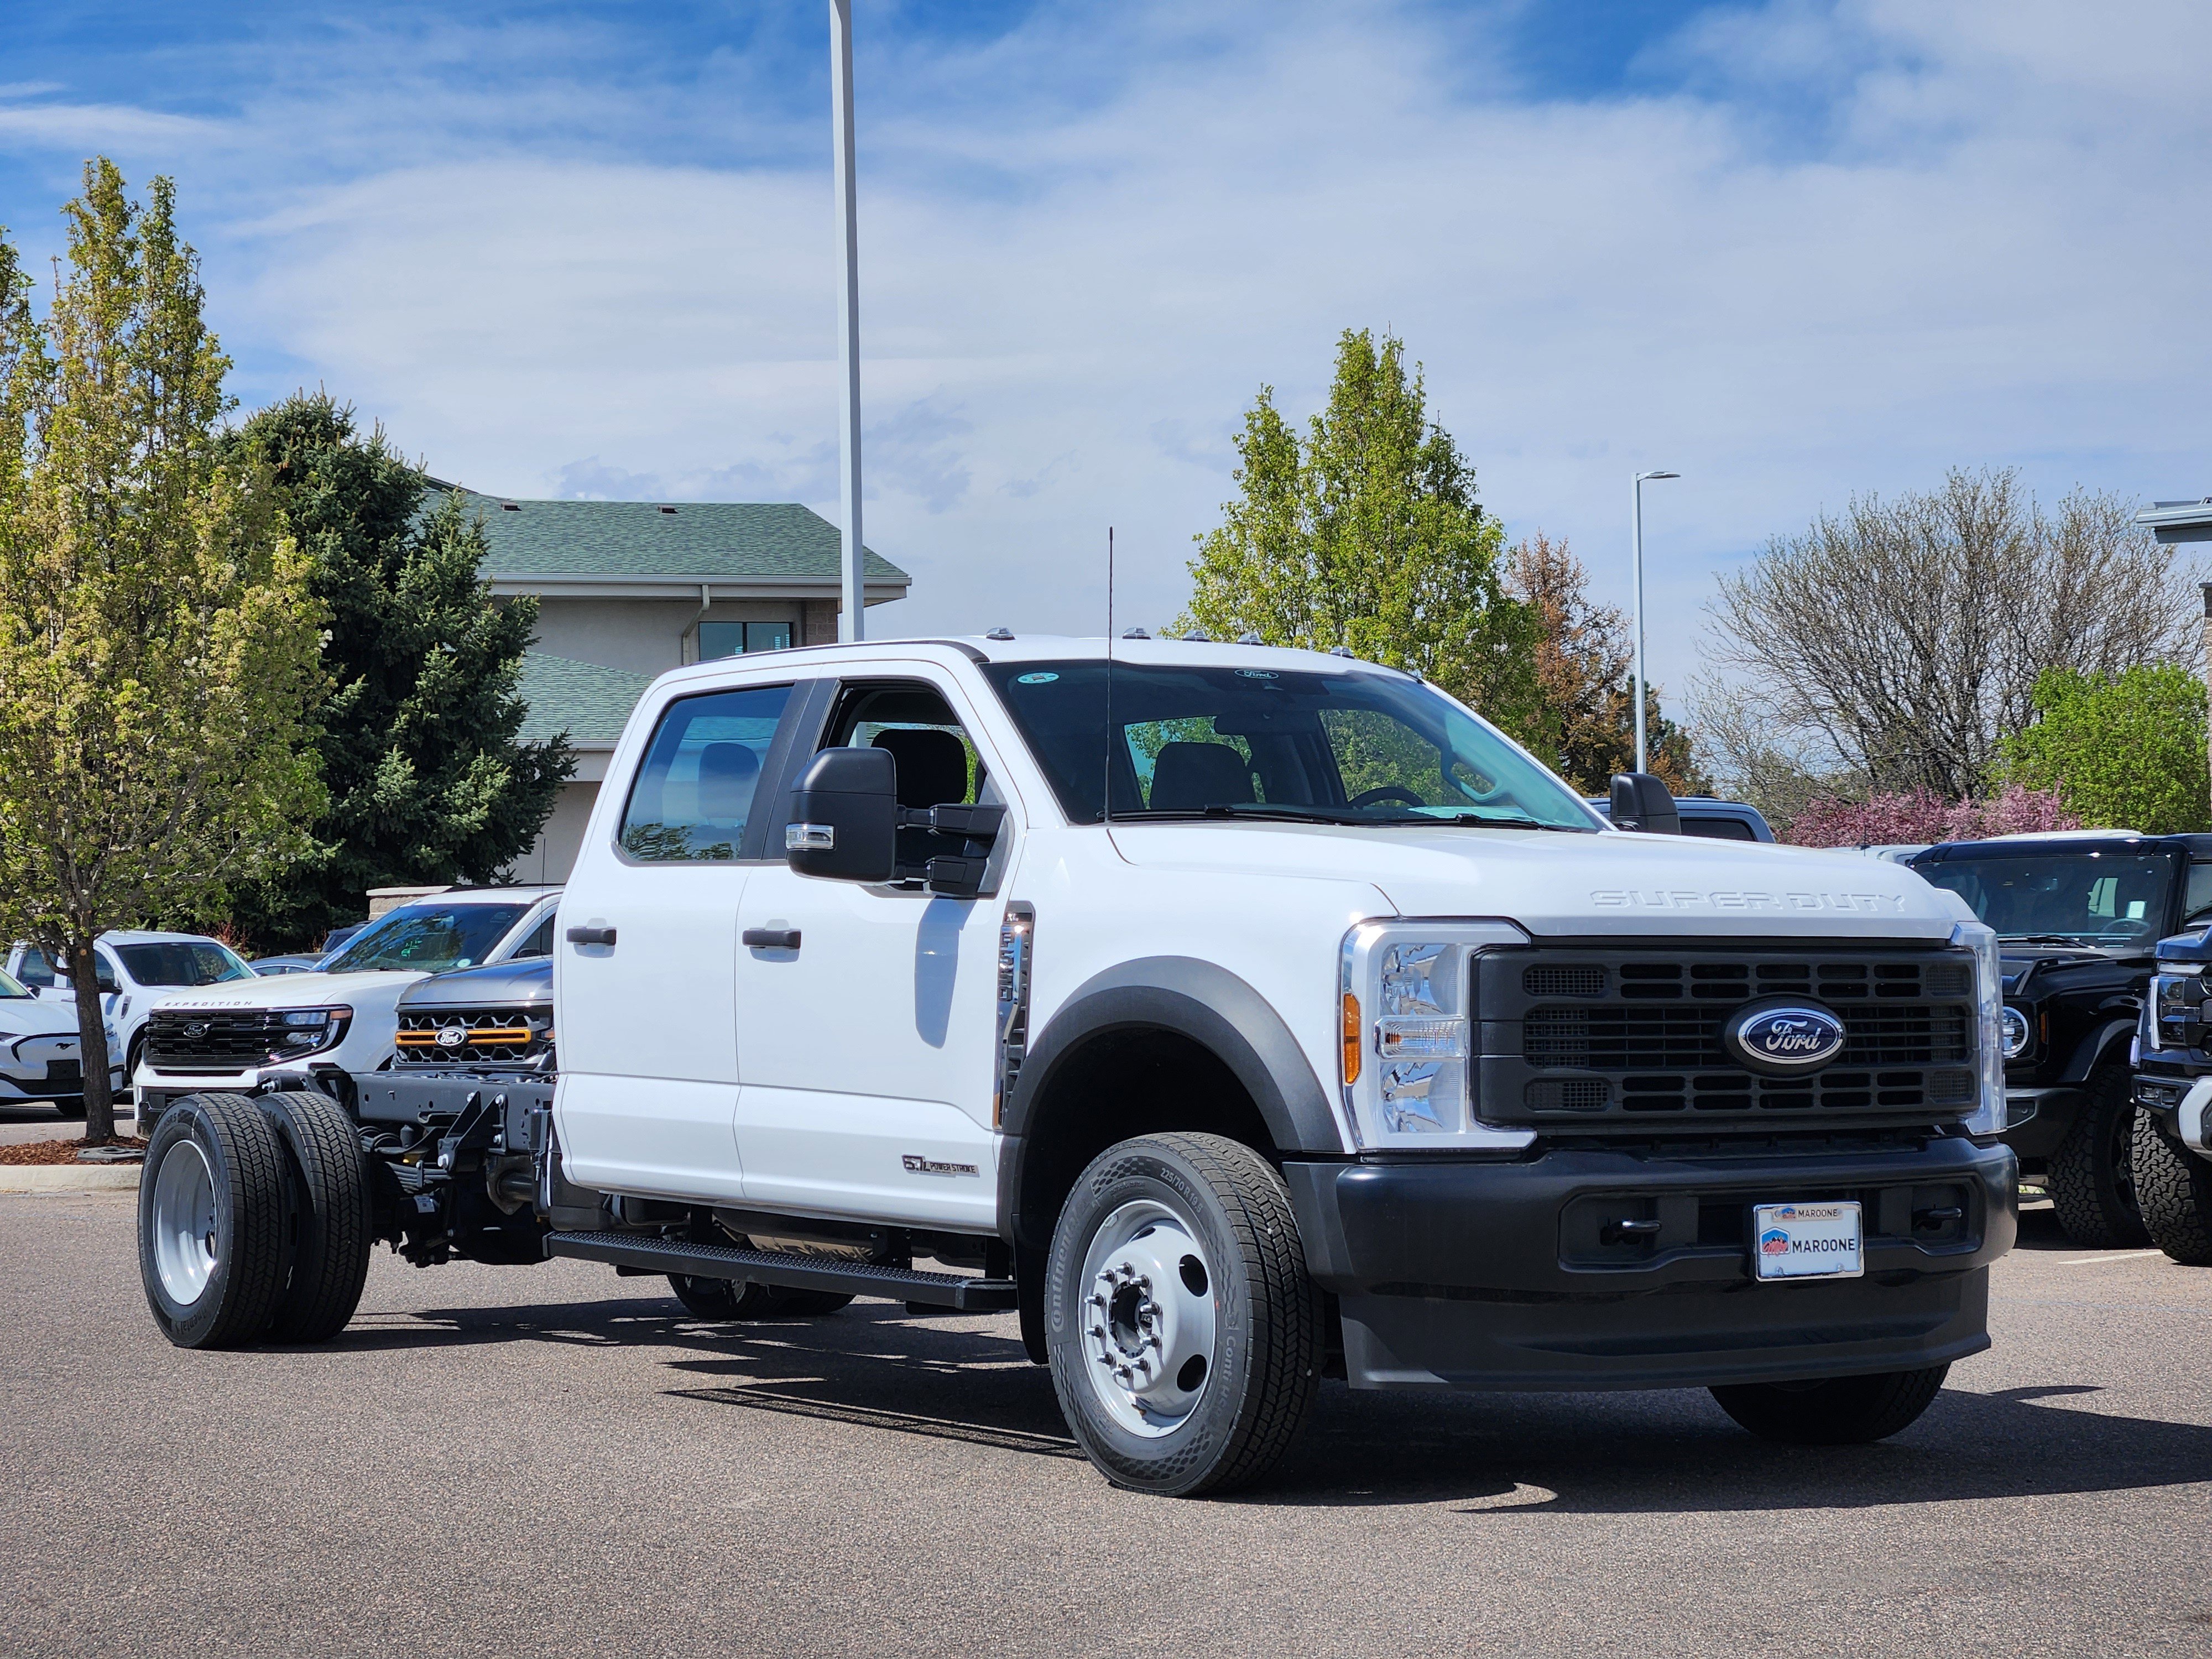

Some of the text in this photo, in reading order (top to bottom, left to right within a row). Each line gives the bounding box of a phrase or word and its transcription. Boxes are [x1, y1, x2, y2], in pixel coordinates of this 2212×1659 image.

[1589, 890, 1906, 912] SUPER DUTY
[440, 1031, 460, 1044] Ford
[1766, 1019, 1822, 1051] Ford
[1160, 1167, 1185, 1191] 225/70
[1183, 1186, 1190, 1198] R
[1798, 1208, 1838, 1218] MAROONE
[1792, 1238, 1855, 1254] MAROONE
[1222, 1335, 1237, 1383] Conti
